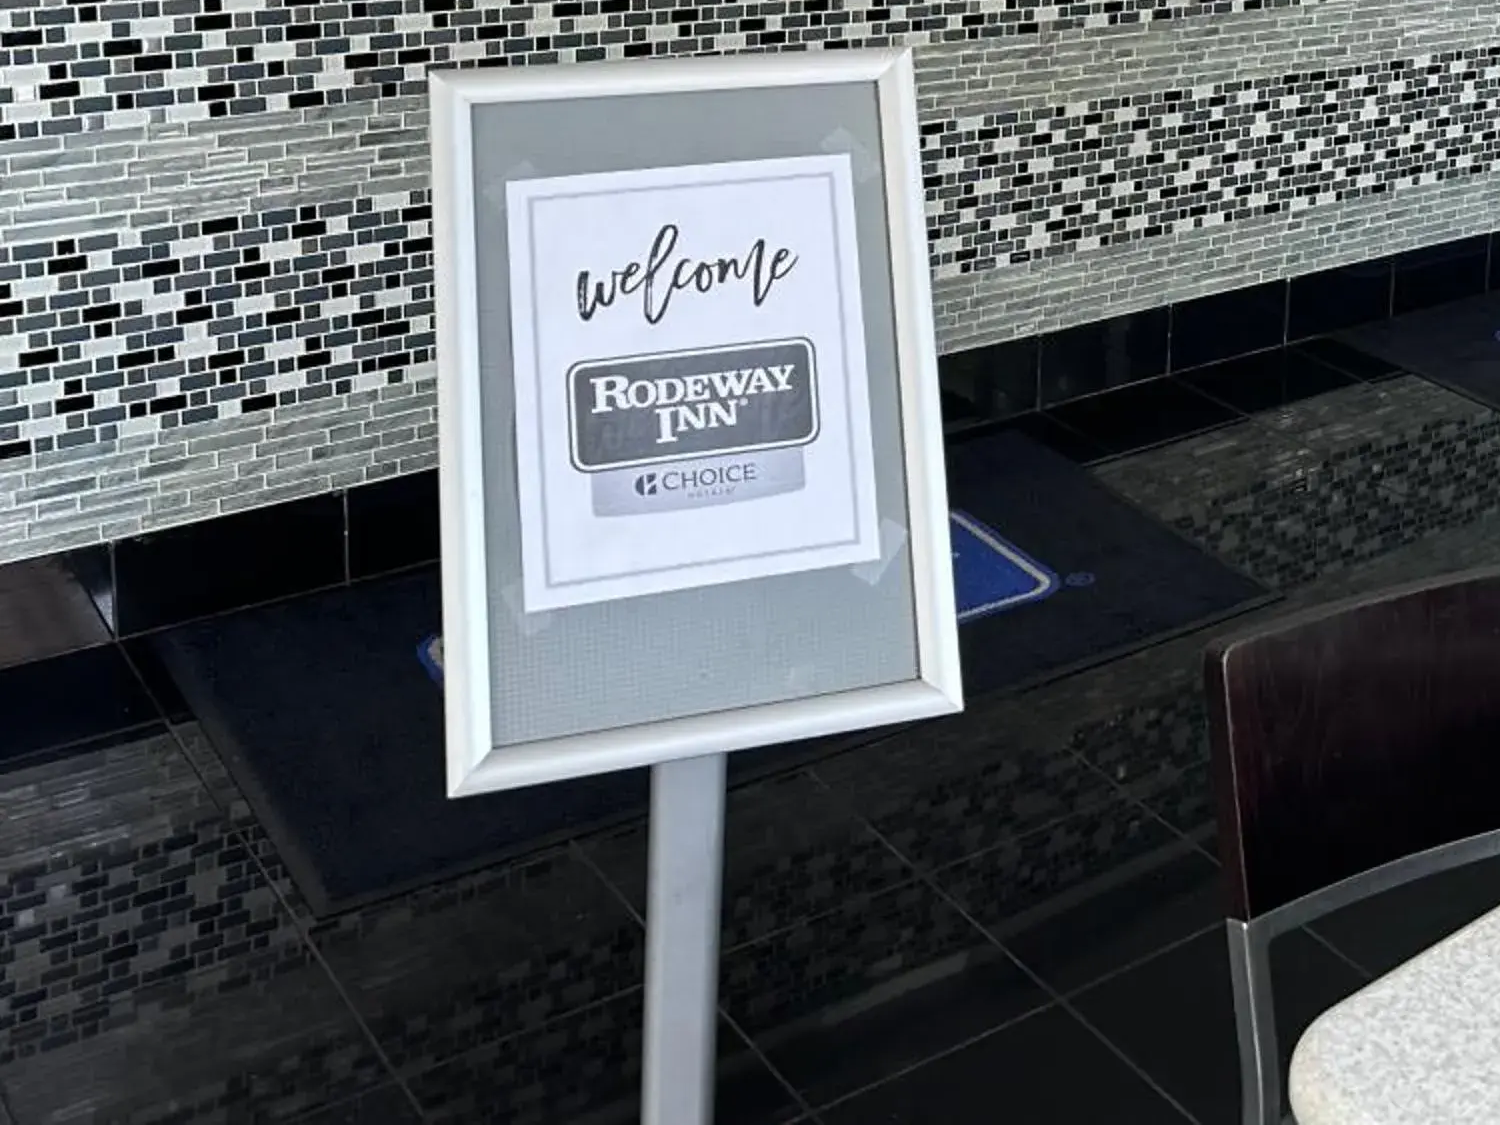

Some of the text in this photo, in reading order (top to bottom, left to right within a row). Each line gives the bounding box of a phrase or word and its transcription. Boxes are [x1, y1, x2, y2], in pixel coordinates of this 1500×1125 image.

[576, 223, 799, 326] welcome
[589, 364, 796, 414] RODEWAY
[655, 399, 739, 444] INN
[661, 462, 757, 492] CHOICE
